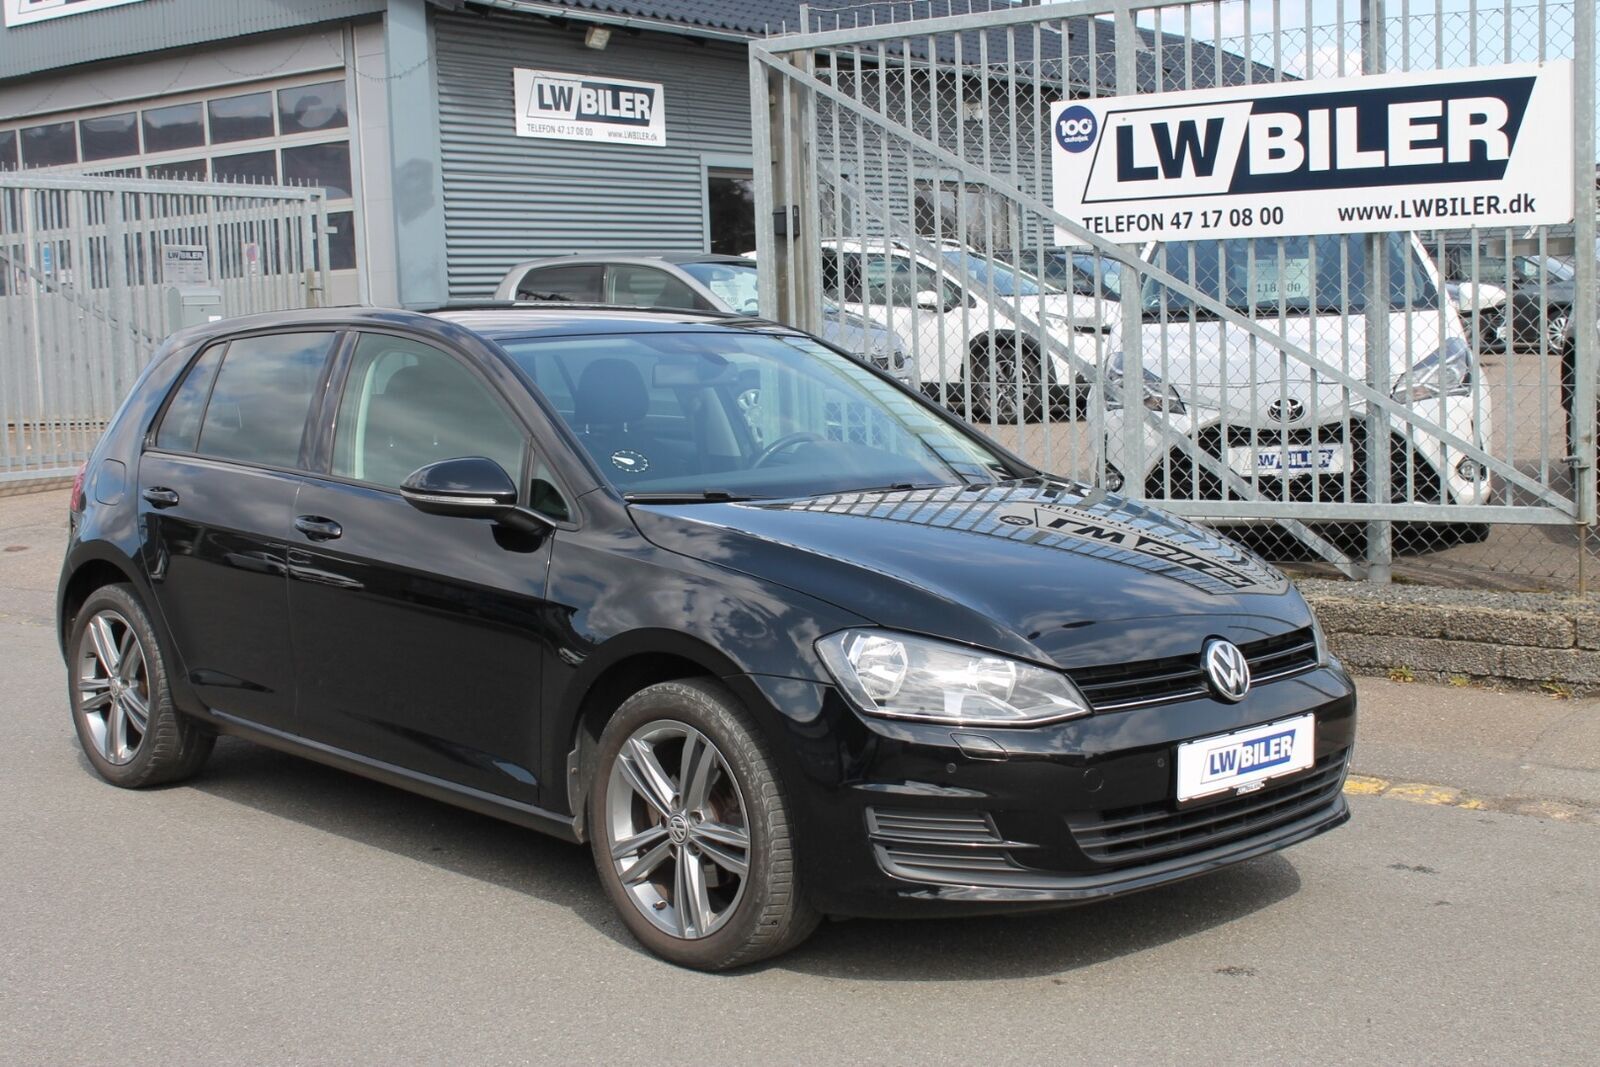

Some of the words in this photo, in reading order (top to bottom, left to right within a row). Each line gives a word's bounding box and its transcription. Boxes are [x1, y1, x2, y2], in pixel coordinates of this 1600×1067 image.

[527, 123, 556, 134] TELEFON
[607, 129, 658, 142] www.LWBILER.dk
[1337, 192, 1536, 222] www.LWBILER.dk
[1082, 212, 1164, 234] TELEFON
[1170, 211, 1193, 230] 47
[1201, 209, 1223, 228] 17
[1229, 207, 1253, 227] 08
[1259, 206, 1284, 225] 00
